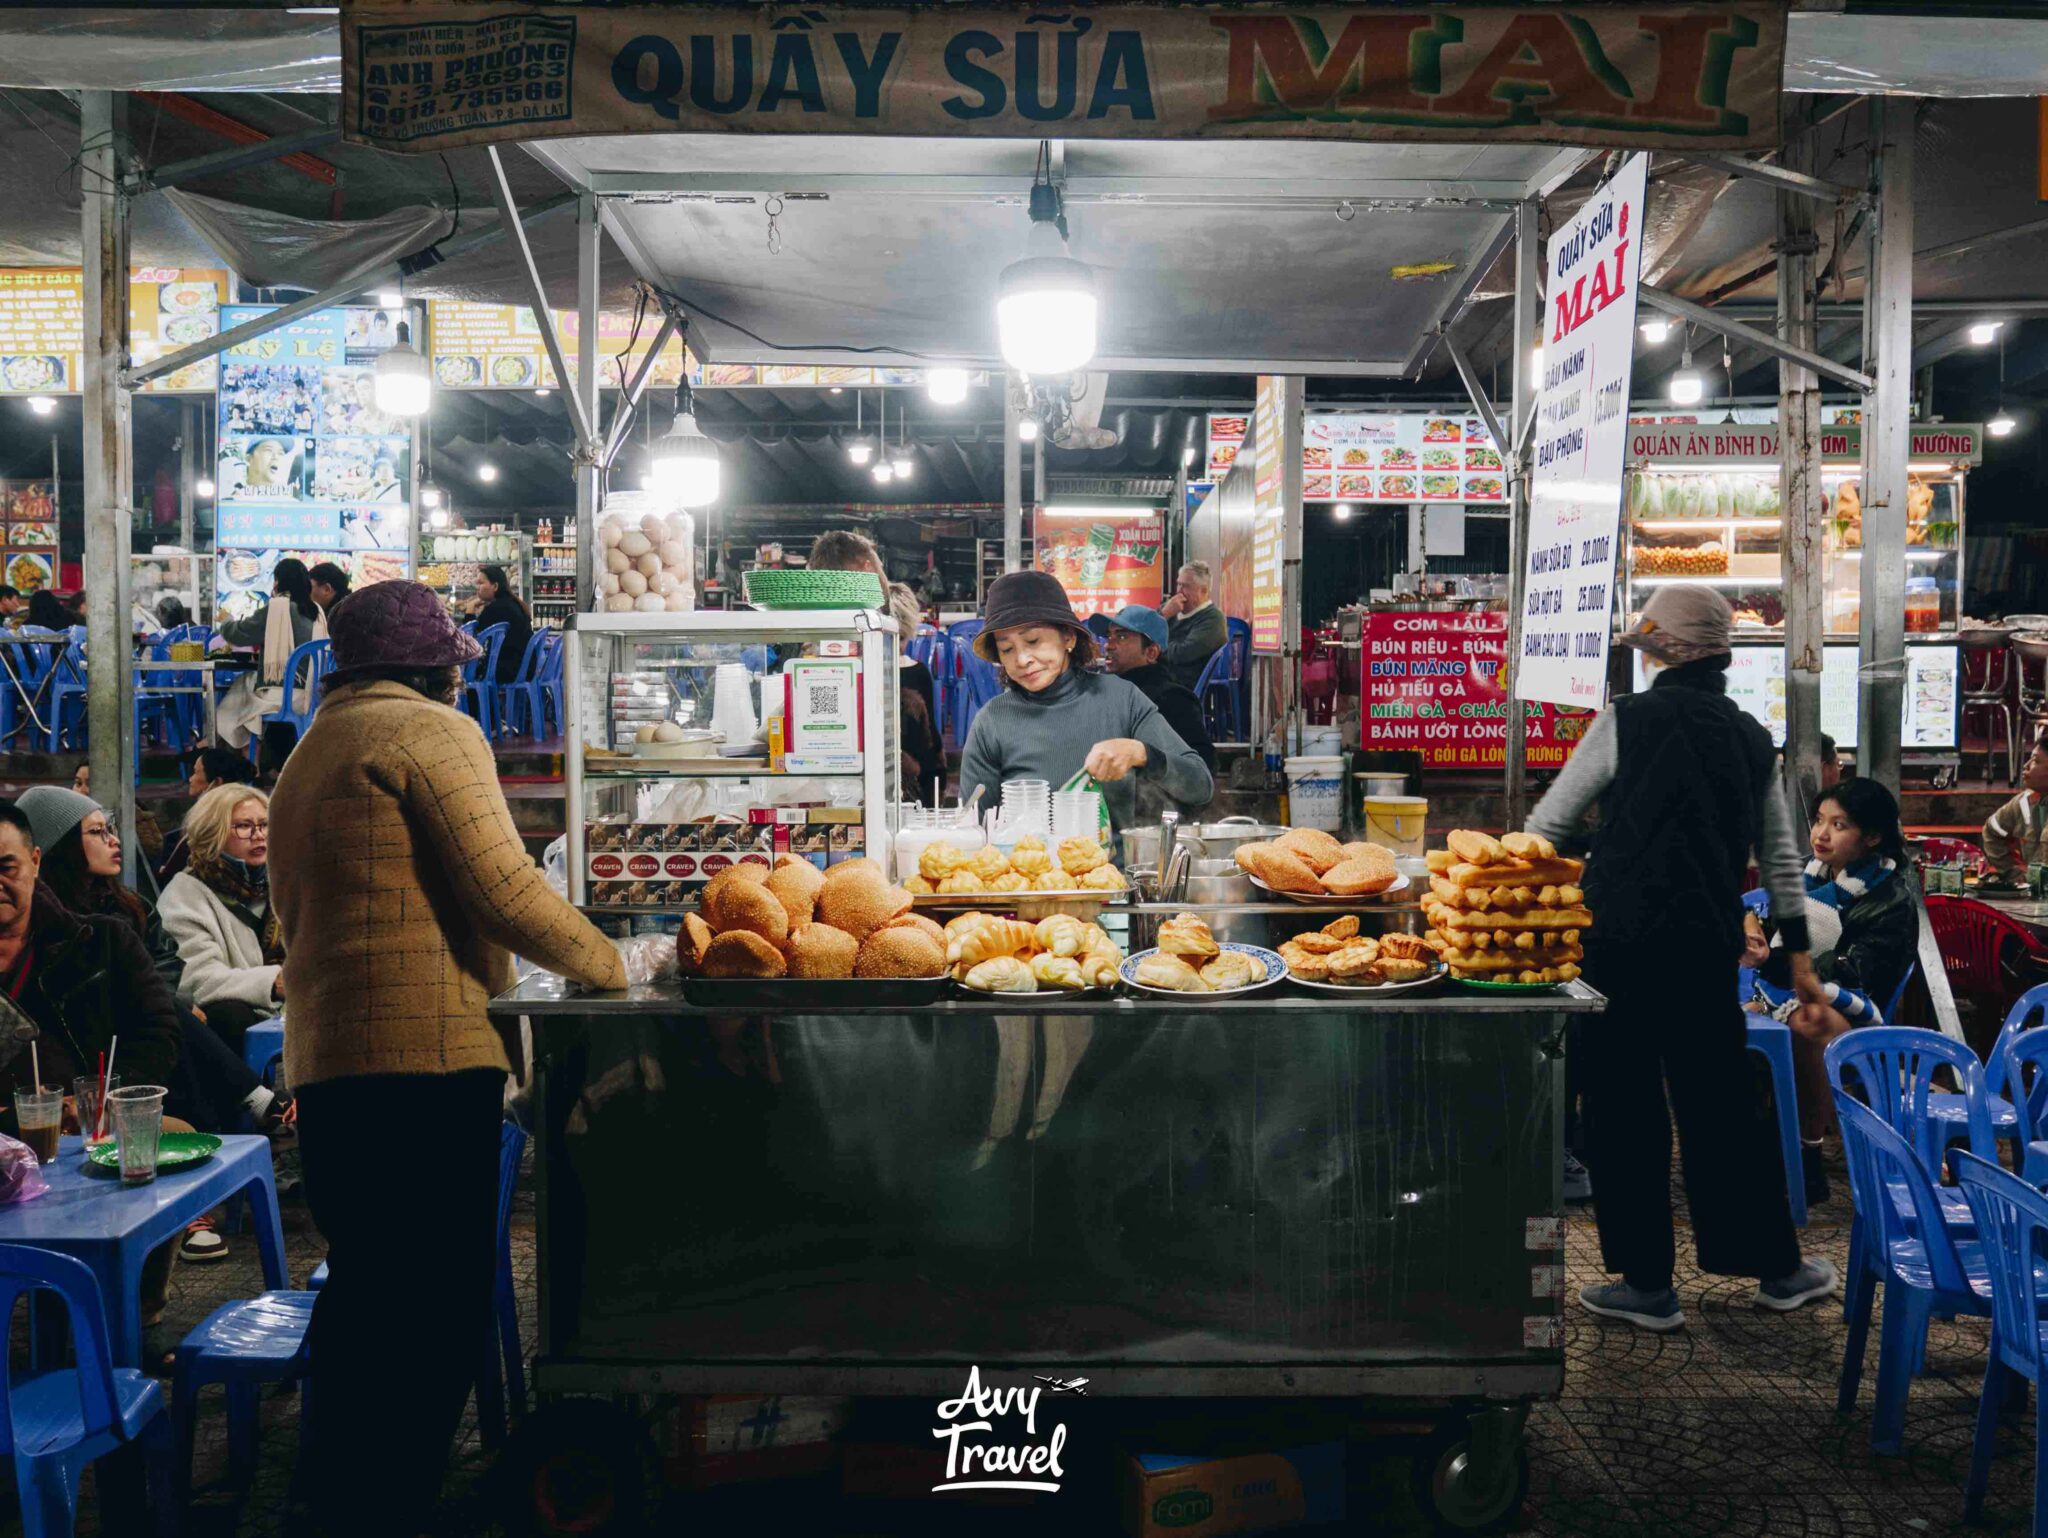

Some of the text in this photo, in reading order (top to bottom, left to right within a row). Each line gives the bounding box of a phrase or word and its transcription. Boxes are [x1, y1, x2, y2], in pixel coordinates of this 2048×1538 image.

[367, 42, 567, 85] ANH PHƯƠNG
[611, 10, 1758, 137] QUẦY SỮA MAI
[1557, 203, 1613, 277] QUẦY SỮA
[1553, 241, 1629, 344] MAI
[1539, 427, 1583, 470] ĐẬU PHỘNG
[1633, 431, 1682, 456] QUÁN
[1686, 430, 1710, 455] ĂN
[1714, 430, 1759, 456] BÌNH
[1822, 434, 1847, 454] ƠM
[1912, 433, 1972, 454] NƯỚNG
[1549, 545, 1562, 573] SỮA
[1581, 535, 1609, 566] 20.000đ
[1528, 584, 1606, 620] SỮA HỘT GÀ 25.000đ
[1393, 618, 1438, 632] CƠM
[1453, 616, 1487, 632] LẨU
[1371, 638, 1405, 655] BÚN
[1411, 639, 1447, 655] RIÊU
[1463, 638, 1497, 655] BÚN
[1525, 629, 1602, 664] BÁNH CÁC LOẠI 10.000đ
[1371, 658, 1497, 680] BÚN MĂNG VỊT
[1371, 676, 1467, 697] HỦ TIẾU GÀ
[1370, 699, 1412, 718] MIẾN
[1417, 702, 1446, 718] GÀ
[1371, 724, 1419, 739] BÁNH
[1425, 723, 1459, 739] ƯỚT
[1434, 744, 1457, 763] GỎI
[1460, 745, 1479, 763] GÀ
[1481, 744, 1506, 762] LÒN
[1526, 744, 1564, 763] RỨNG
[593, 863, 621, 871] CRAVEN
[629, 863, 658, 871] CRAVEN
[666, 863, 695, 871] CRAVEN
[1156, 1499, 1211, 1521] Fami
